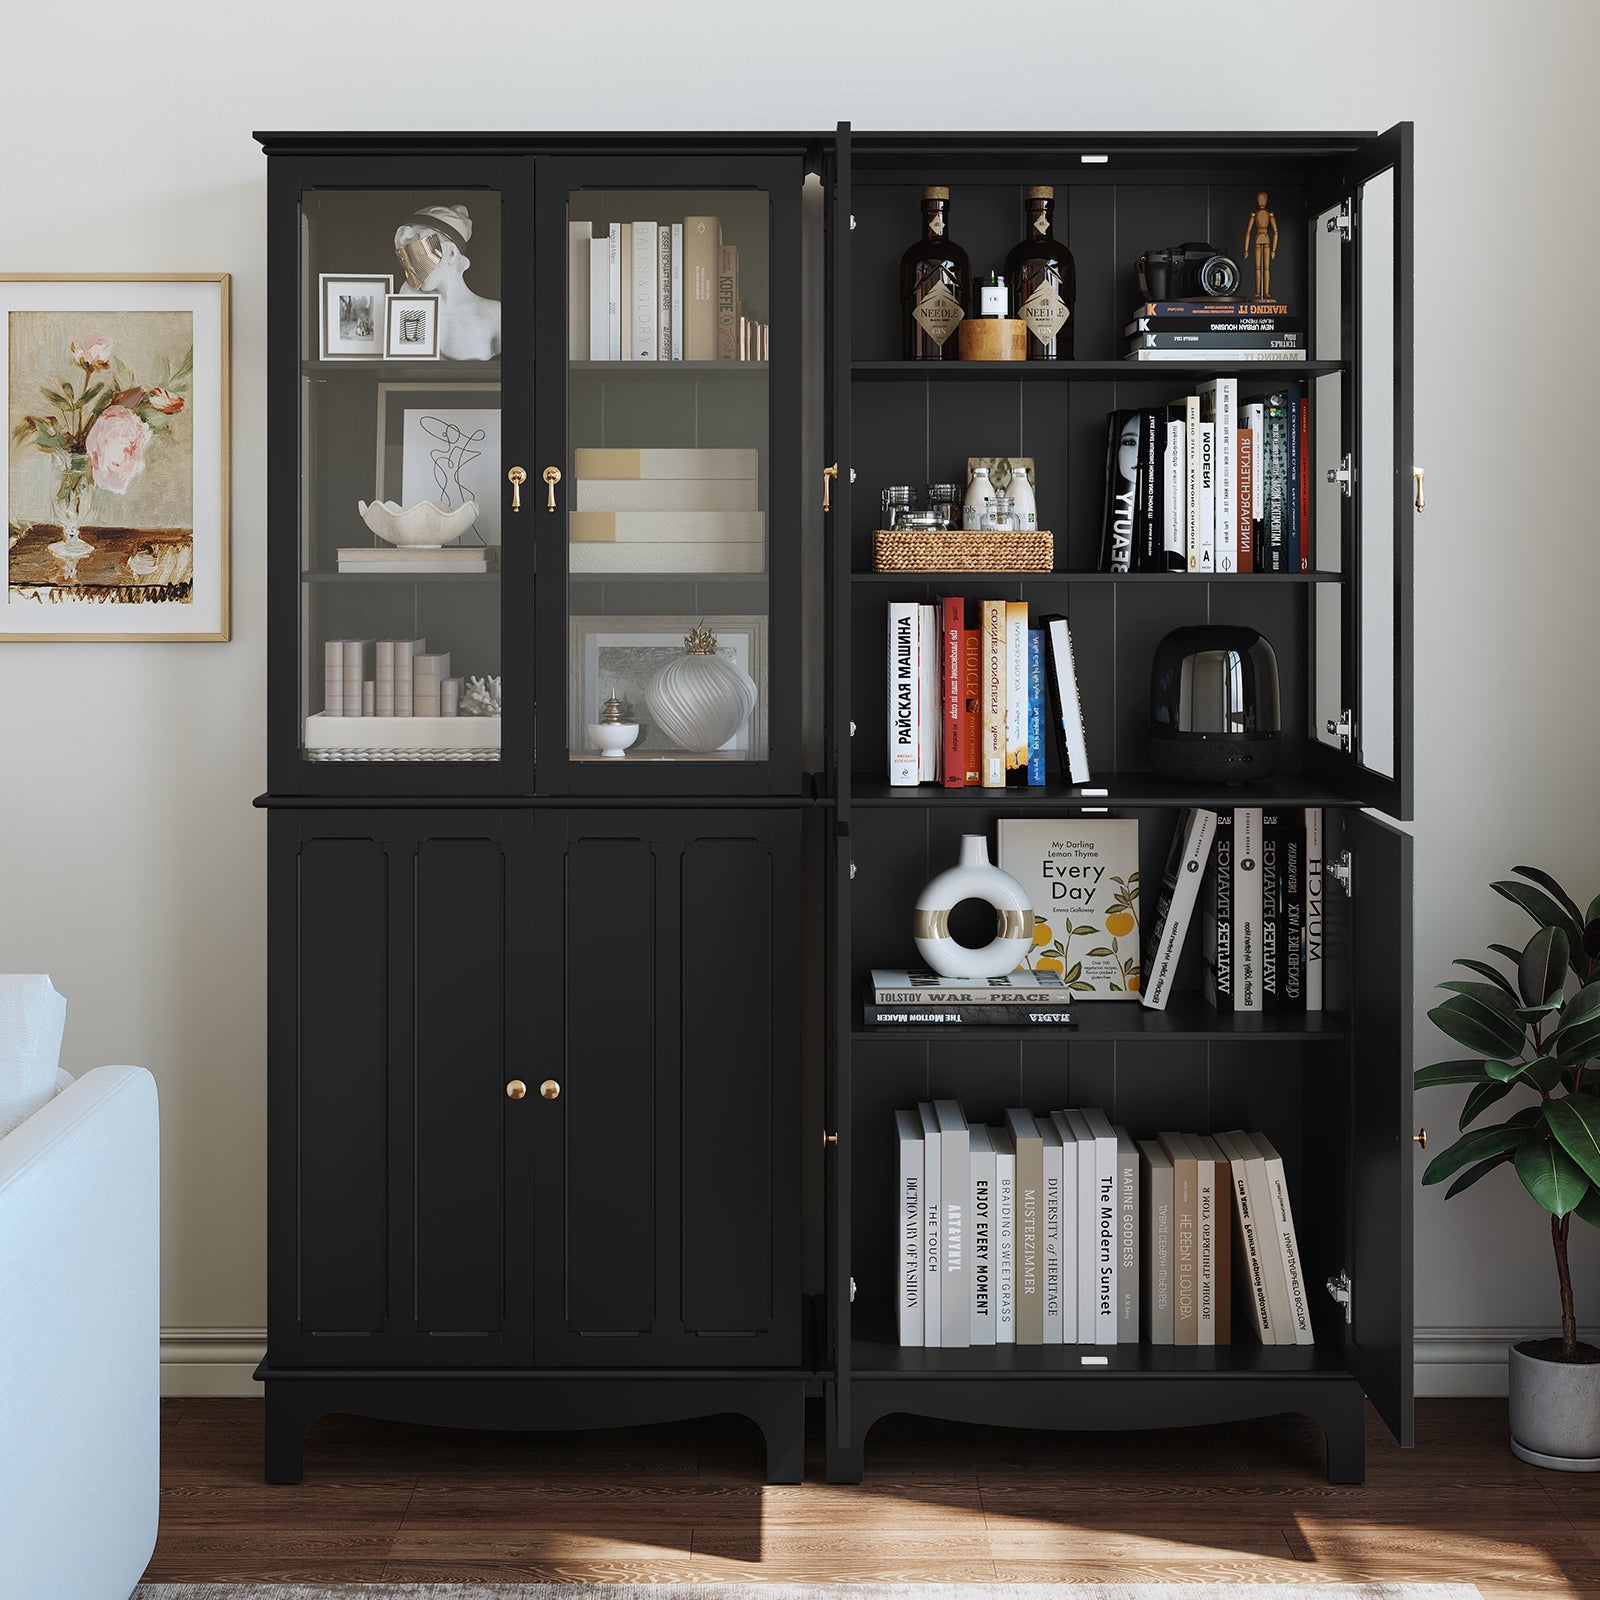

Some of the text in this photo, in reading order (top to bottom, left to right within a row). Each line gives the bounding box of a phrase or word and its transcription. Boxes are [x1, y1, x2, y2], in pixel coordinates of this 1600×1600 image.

[638, 294, 651, 345] GLORY
[720, 277, 733, 312] KOFFIE
[920, 309, 959, 318] NEEDLE
[1238, 305, 1248, 314] IT
[1250, 305, 1287, 314] MAKING
[898, 617, 911, 678] МАШИНА
[894, 683, 912, 744] РАЙСКАЯ
[1052, 841, 1094, 850] My Darling
[1074, 851, 1099, 859] Thyme
[1043, 860, 1105, 883] Every
[1052, 882, 1096, 905] Day
[877, 1014, 961, 1022] THE MOTION MAKER
[880, 993, 922, 1002] TOLSTOY
[906, 1177, 918, 1308] DICTIONARY OF FASHION
[929, 1205, 937, 1272] THE TOUCH
[1025, 1190, 1035, 1295] MUSTERZIMMER
[1124, 1168, 1133, 1267] MARINE GODDESS
[977, 1181, 987, 1316] ENJOY EVERY MOMENT
[1002, 1179, 1011, 1322] BRAIDING SWEETGRASS
[1046, 1178, 1058, 1316] DIVERSITY of HERITAGE
[1101, 1176, 1112, 1316] The Modern Sunset
